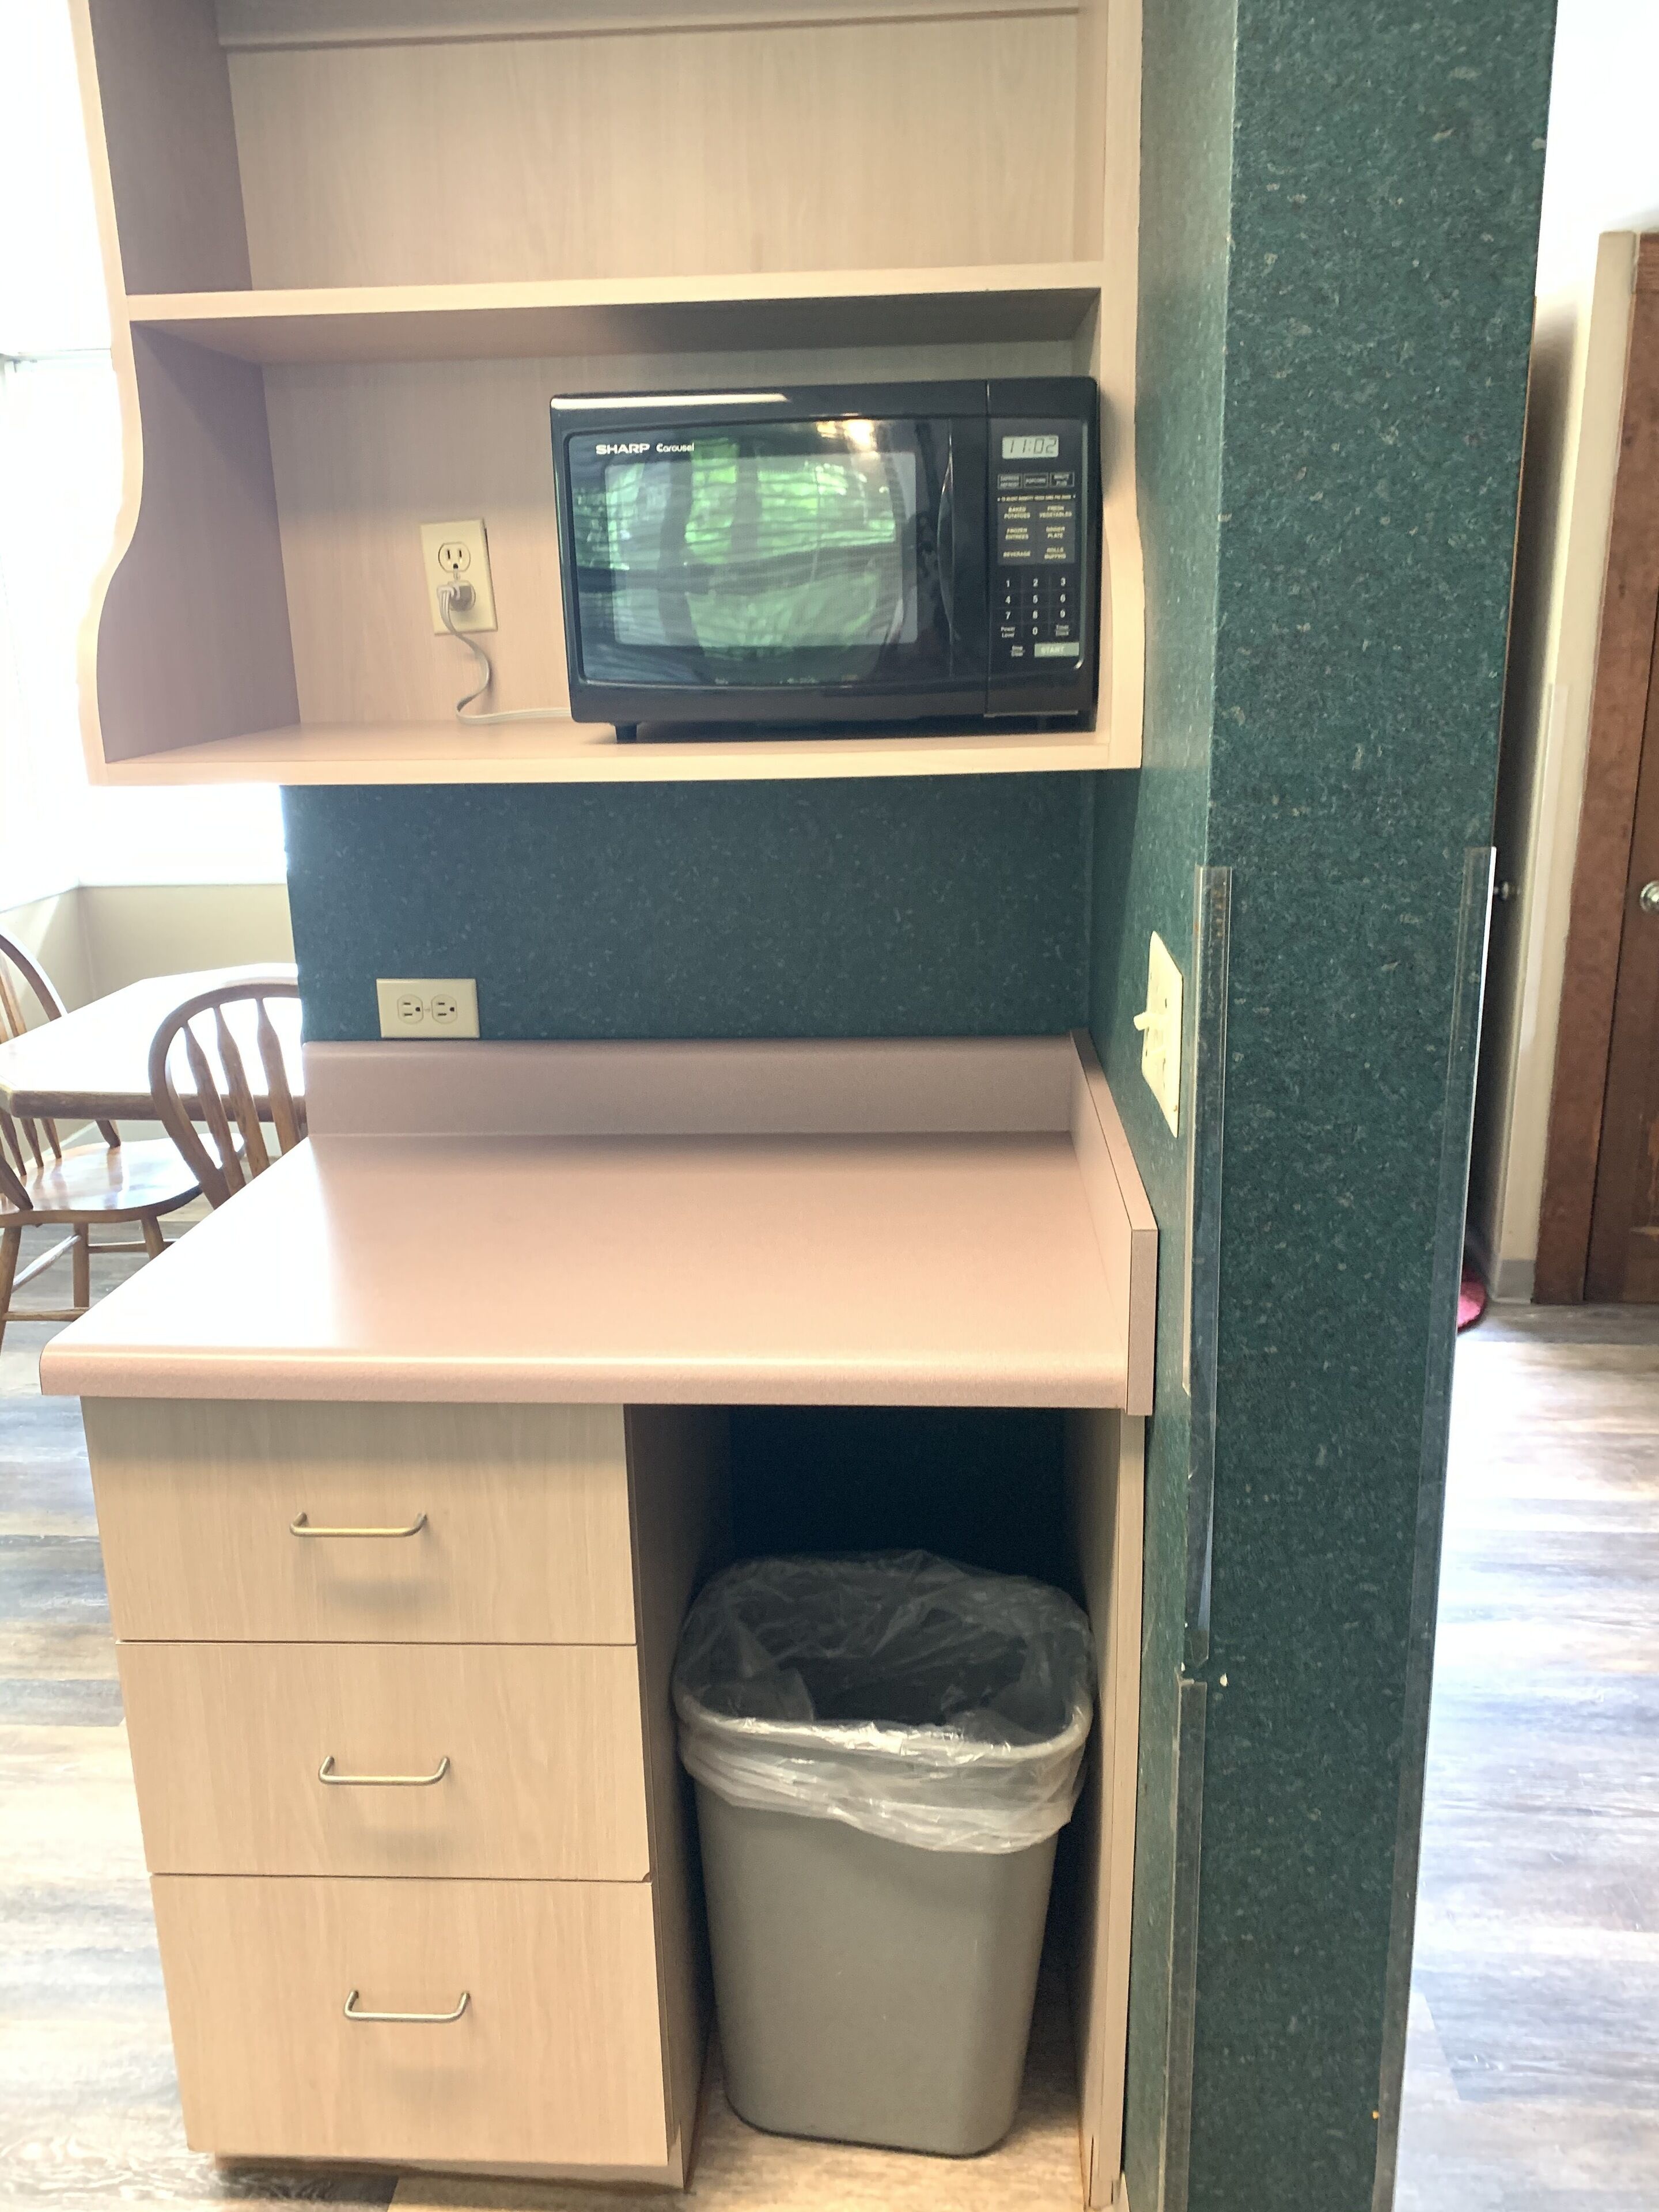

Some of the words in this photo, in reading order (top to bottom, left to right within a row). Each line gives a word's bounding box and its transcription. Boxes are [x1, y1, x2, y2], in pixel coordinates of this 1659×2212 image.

[596, 443, 650, 455] SHARP
[656, 442, 695, 453] Carousel
[1010, 437, 1057, 454] 11:02
[1006, 579, 1010, 588] 1
[1033, 578, 1039, 587] 2
[1060, 577, 1066, 586] 3
[1005, 595, 1011, 604] 4
[1033, 594, 1038, 604] 5
[1060, 593, 1066, 603] 6
[1005, 611, 1011, 620] 7
[1032, 610, 1038, 619] 8
[1032, 626, 1038, 635] 0
